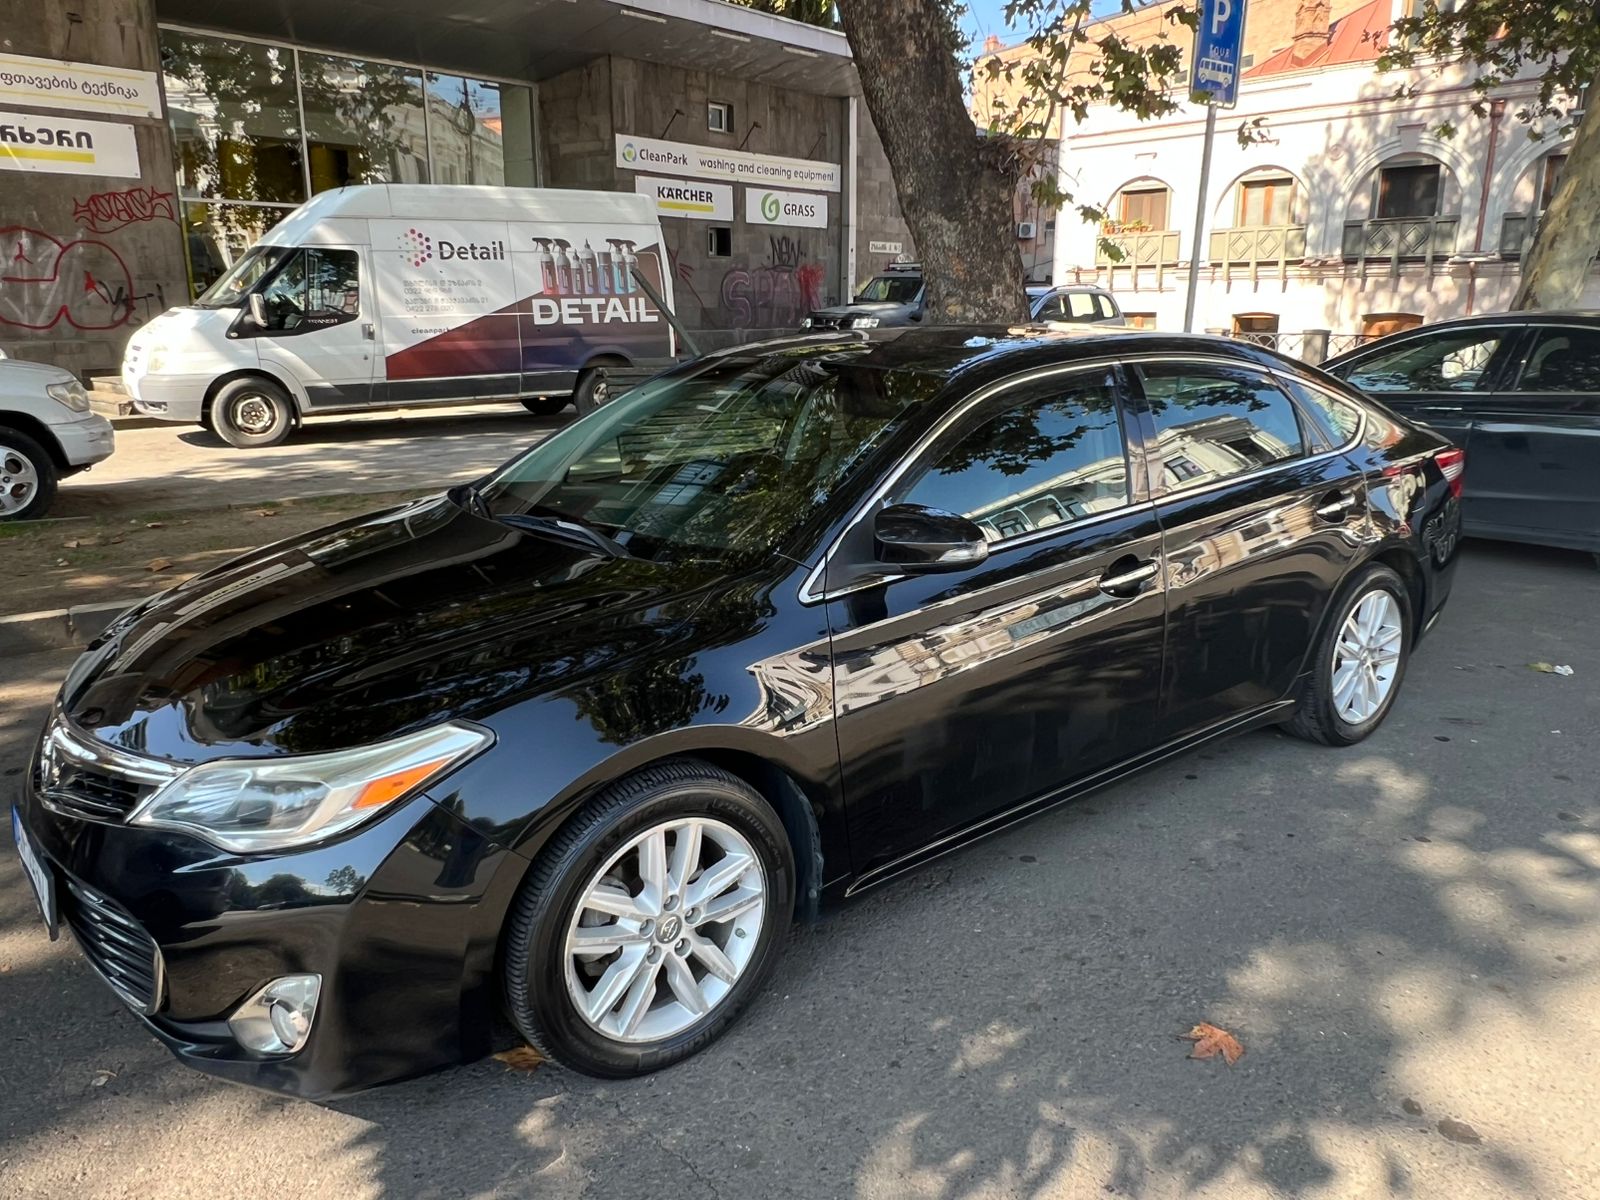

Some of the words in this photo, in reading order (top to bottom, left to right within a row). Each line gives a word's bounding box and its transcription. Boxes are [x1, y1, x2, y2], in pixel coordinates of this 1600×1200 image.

[1211, 0, 1231, 34] P
[81, 81, 139, 100] ტექნიკა
[639, 148, 689, 166] CleanPark
[699, 158, 735, 174] washing
[737, 163, 755, 173] and
[756, 165, 792, 179] cleaning
[793, 169, 834, 182] equipment
[657, 186, 714, 203] KÄRCHER
[783, 203, 815, 218] GRASS
[438, 240, 505, 261] Detail
[531, 297, 659, 325] DETAIL
